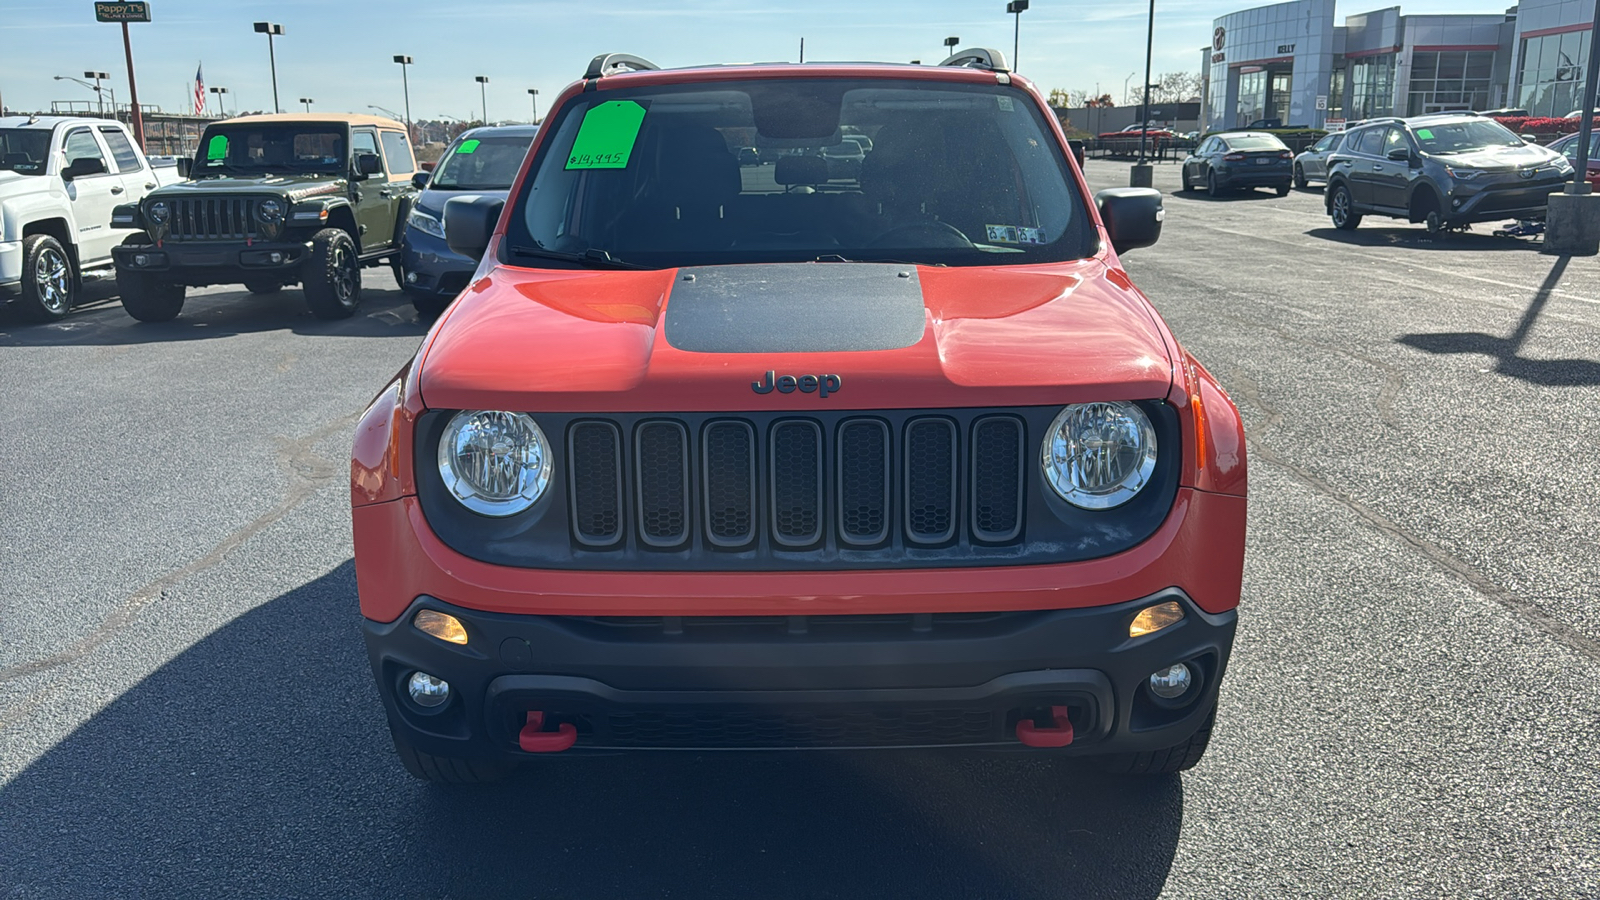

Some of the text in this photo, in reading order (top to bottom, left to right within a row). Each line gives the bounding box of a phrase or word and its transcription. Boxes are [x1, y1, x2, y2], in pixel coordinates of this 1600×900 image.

[97, 4, 143, 13] Pappy T's
[1278, 44, 1295, 54] KELLY
[751, 370, 841, 398] Jeep
